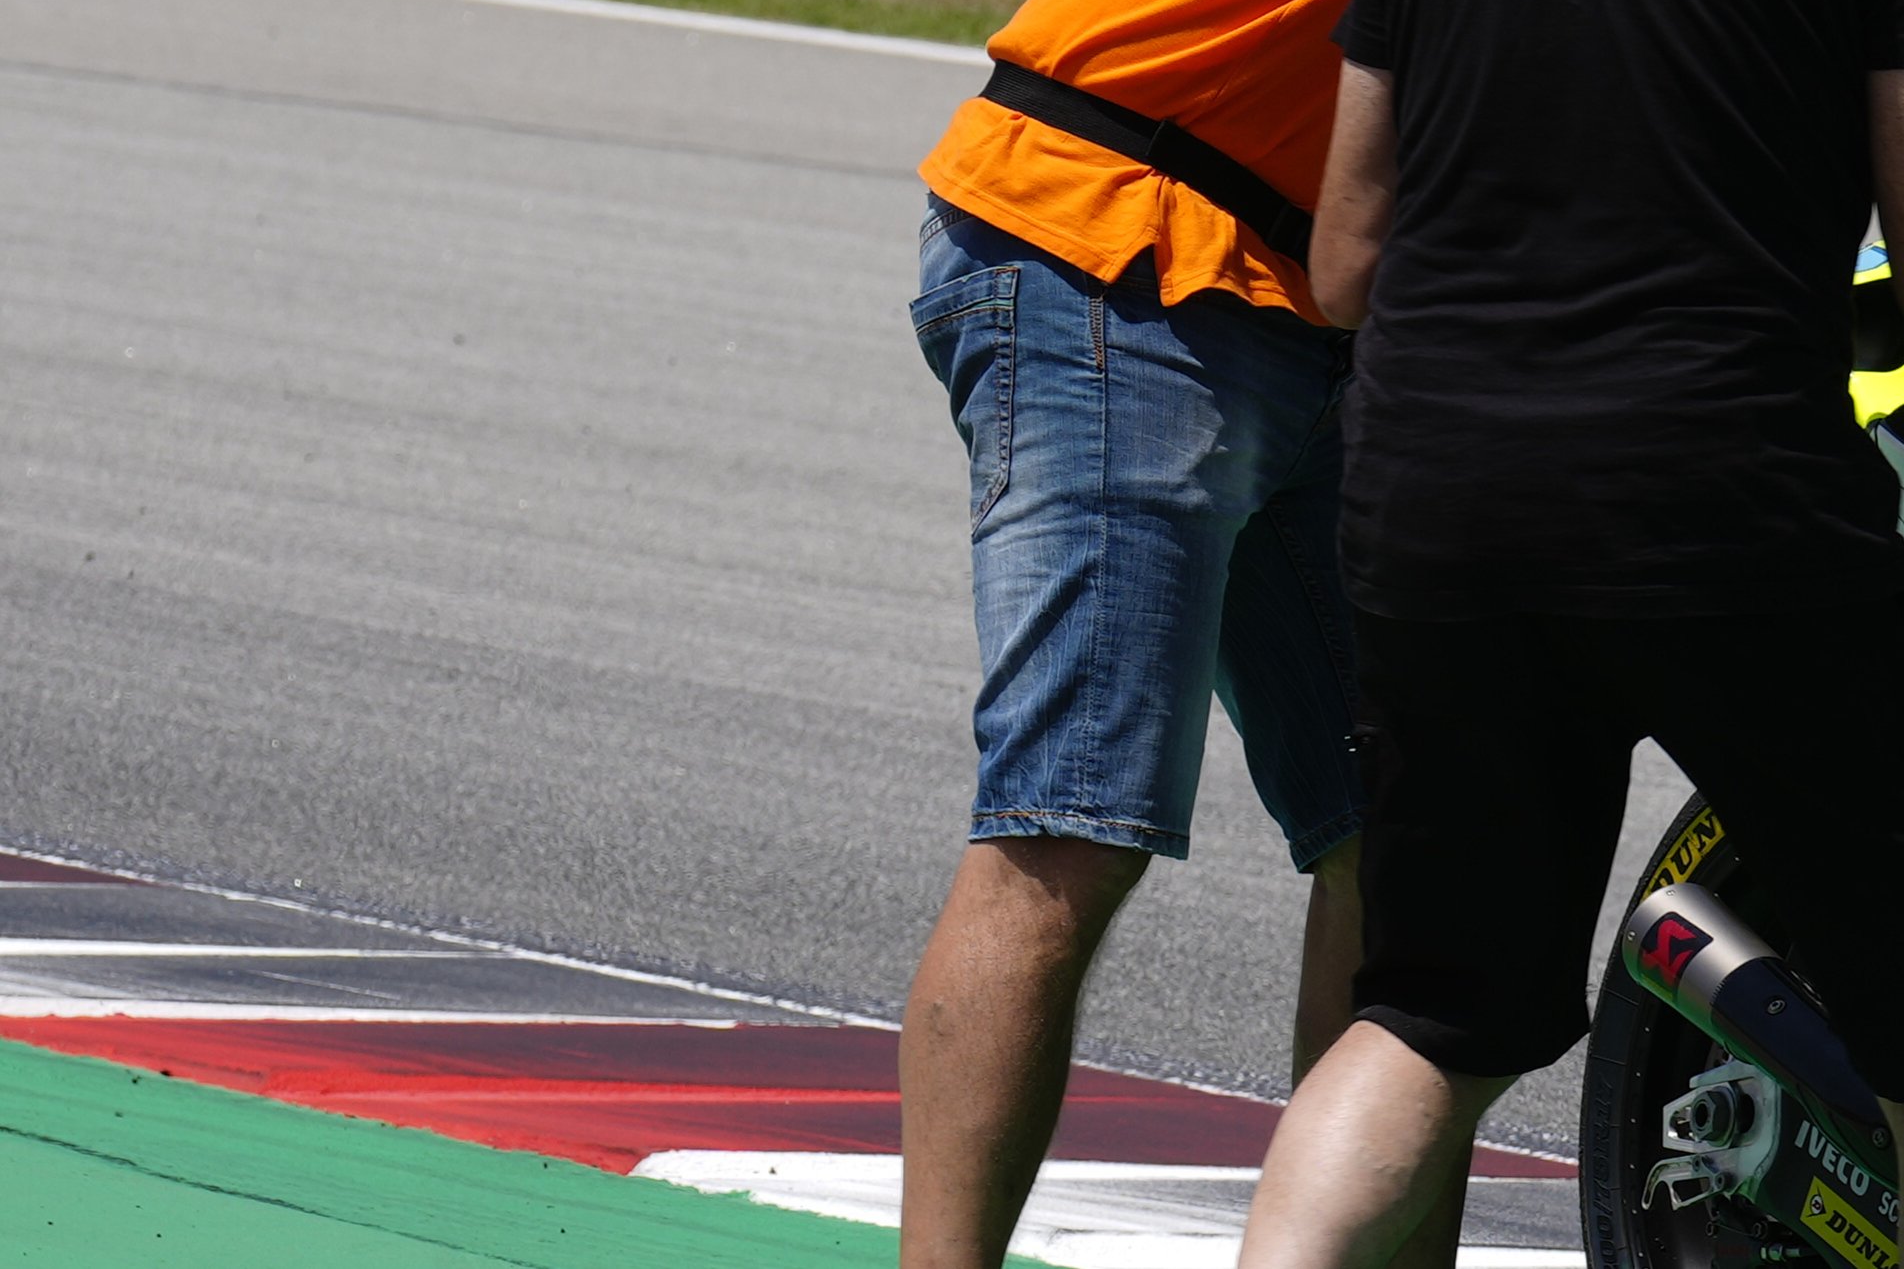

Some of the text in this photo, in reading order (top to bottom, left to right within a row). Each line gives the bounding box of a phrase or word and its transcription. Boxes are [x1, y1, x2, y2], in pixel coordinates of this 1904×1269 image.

[1650, 812, 1717, 893] DUN
[1794, 1119, 1899, 1227] IVECO SC
